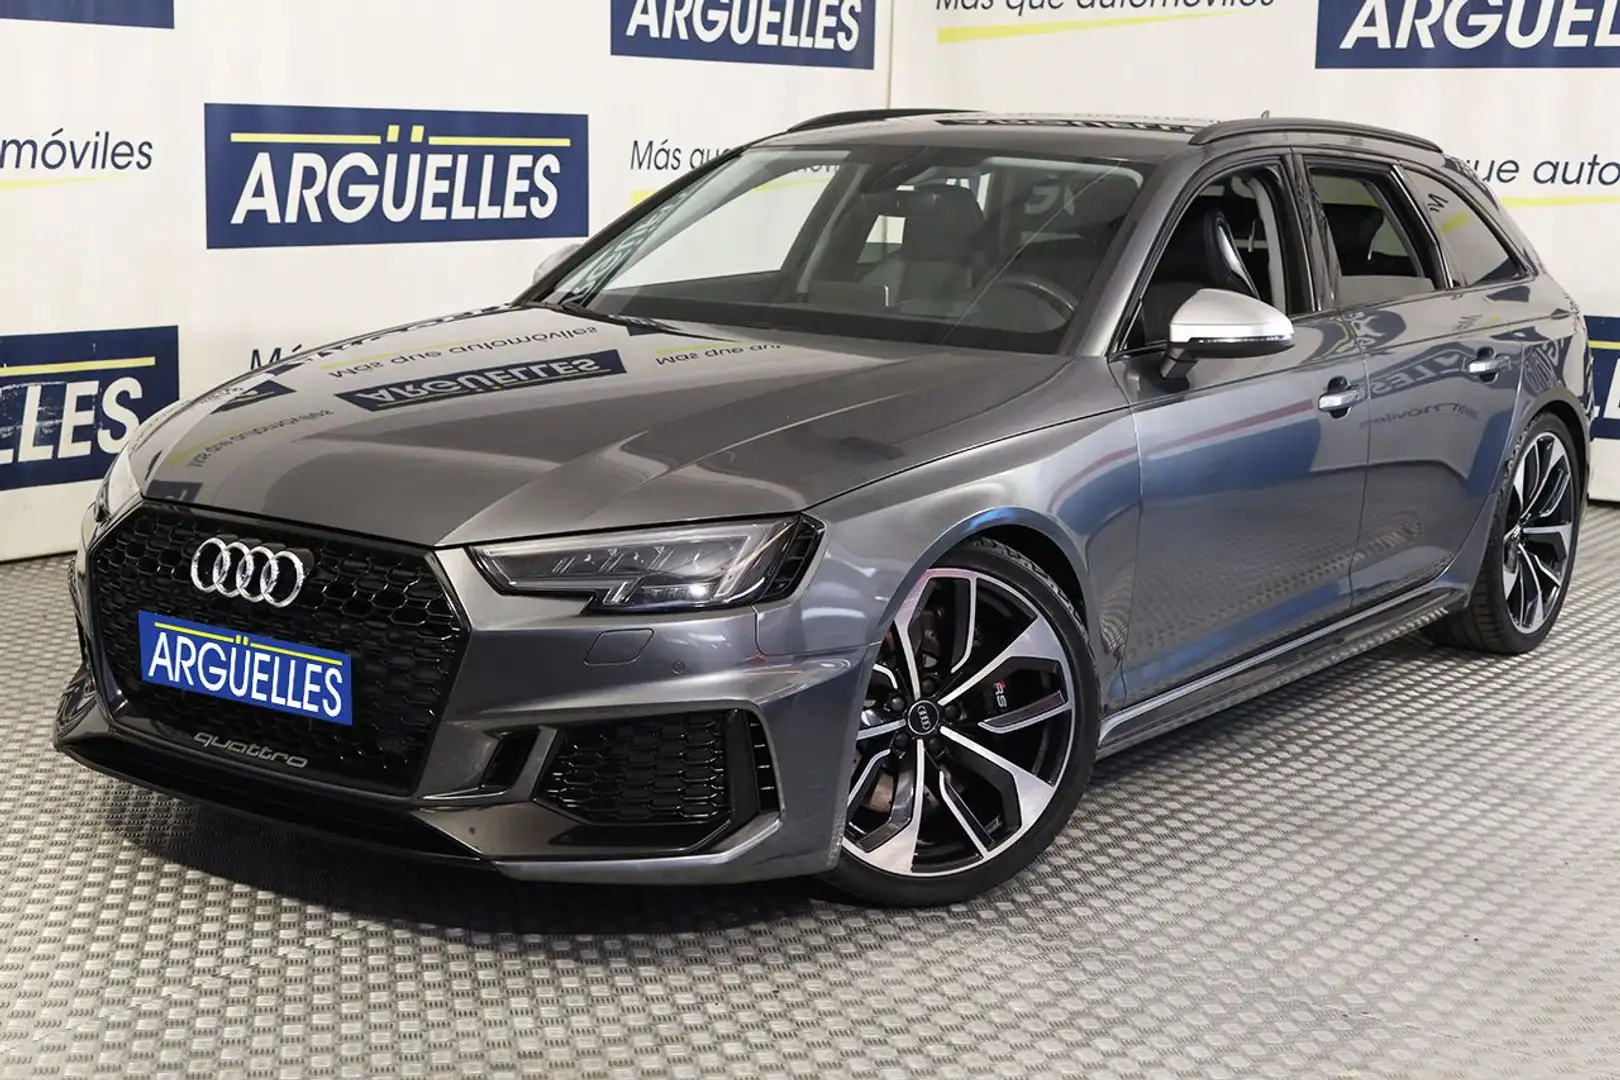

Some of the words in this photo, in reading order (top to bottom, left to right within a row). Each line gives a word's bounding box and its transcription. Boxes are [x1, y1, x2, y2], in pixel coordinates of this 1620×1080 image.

[0, 127, 153, 170] móviles
[630, 138, 682, 170] Más
[230, 125, 561, 224] ARGÜELLES
[1467, 159, 1520, 184] ue
[148, 632, 343, 717] ARGÜELLES
[194, 731, 309, 769] quattro
